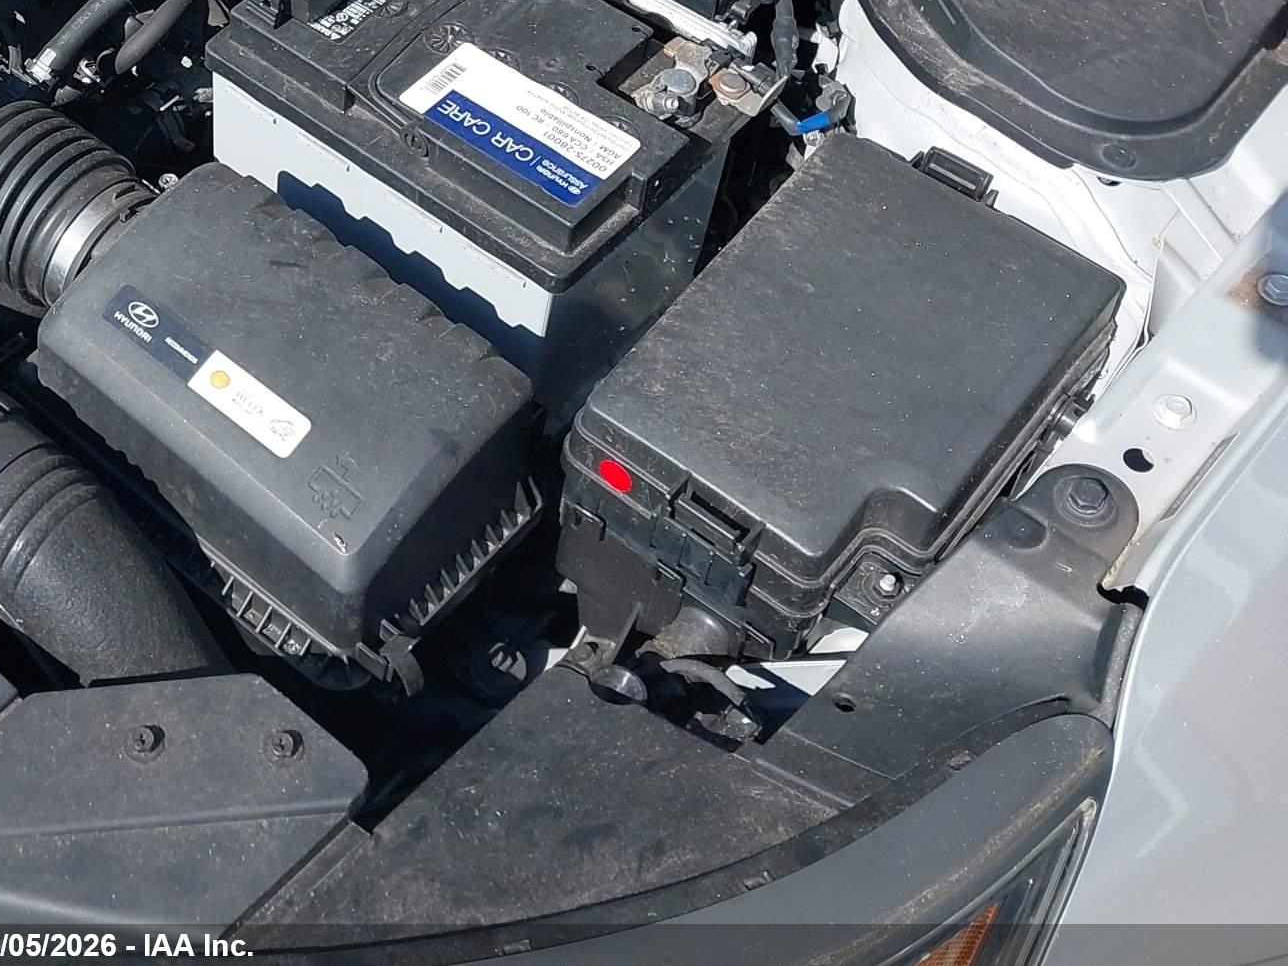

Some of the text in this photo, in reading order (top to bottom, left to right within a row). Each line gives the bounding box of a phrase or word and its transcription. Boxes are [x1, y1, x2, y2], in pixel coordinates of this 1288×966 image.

[435, 97, 493, 136] CARE
[489, 129, 536, 163] CAR
[541, 129, 608, 173] 00275-28001
[540, 157, 589, 190] Assurance
[112, 309, 153, 344] HYUNDAI
